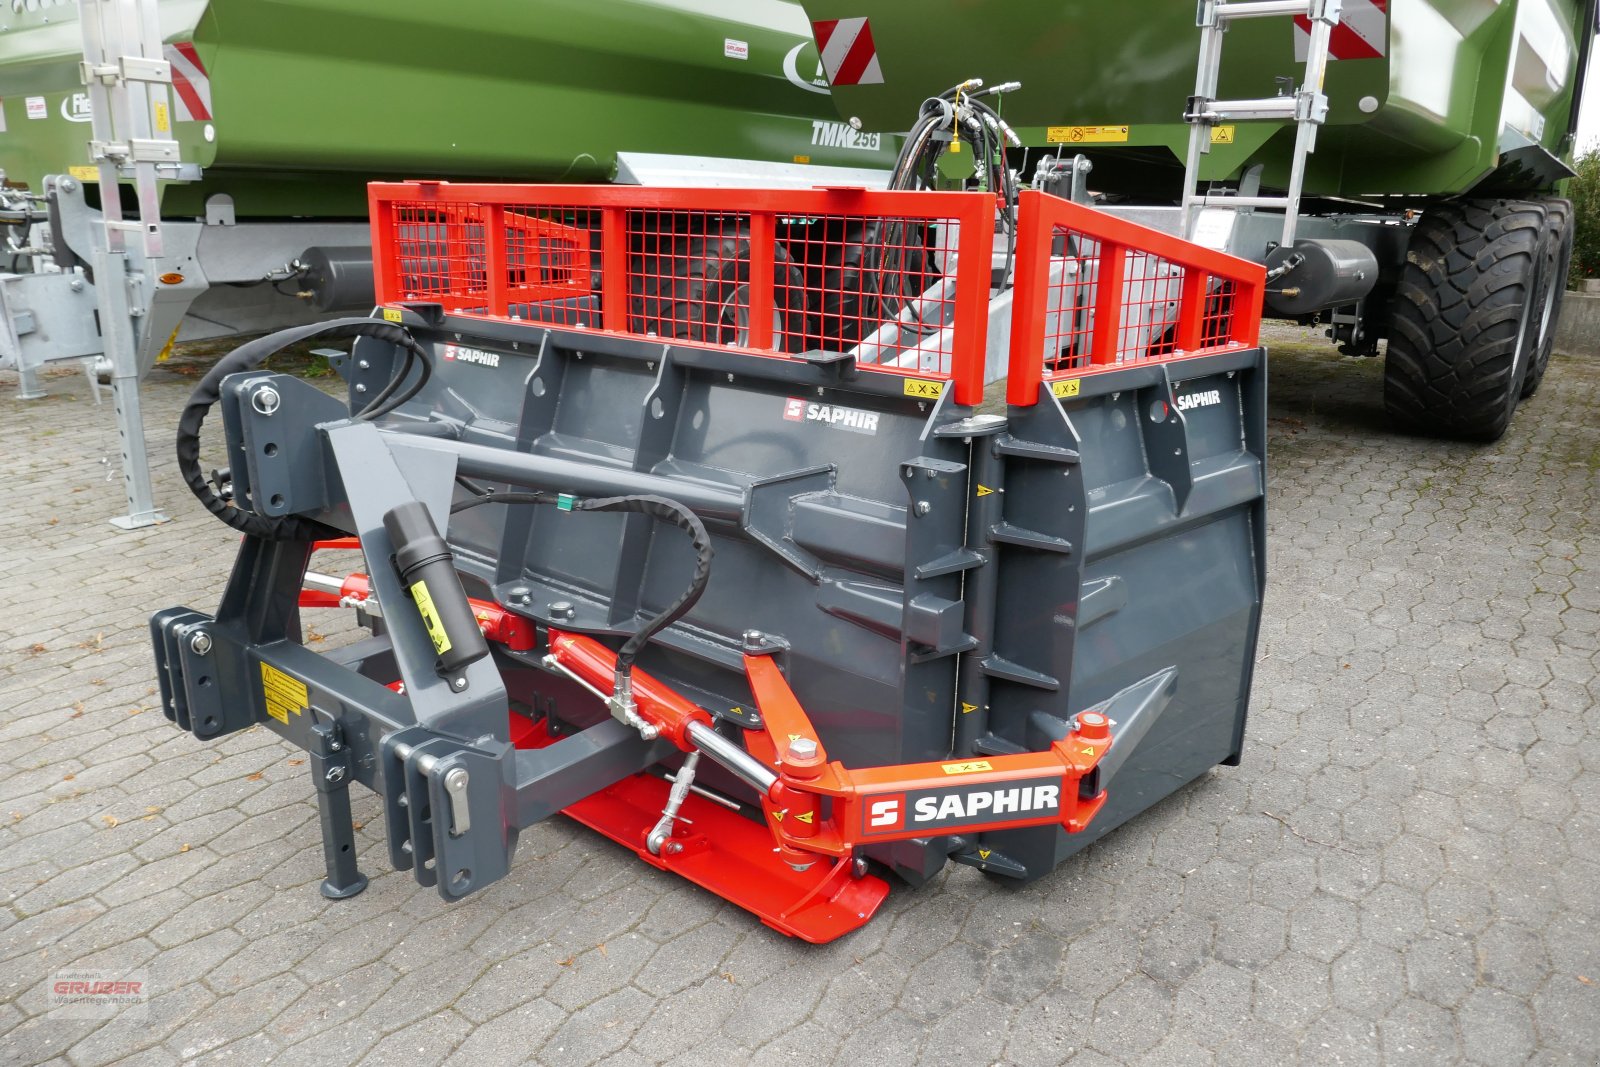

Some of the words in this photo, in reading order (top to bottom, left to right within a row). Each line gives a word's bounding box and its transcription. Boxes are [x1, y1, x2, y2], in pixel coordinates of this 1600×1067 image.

[811, 120, 850, 148] TMK
[853, 130, 877, 148] 256
[457, 346, 500, 368] SAPHIR
[1177, 390, 1221, 411] SAPHIR
[806, 404, 880, 431] SAPHIR
[914, 785, 1060, 822] SAPHIR
